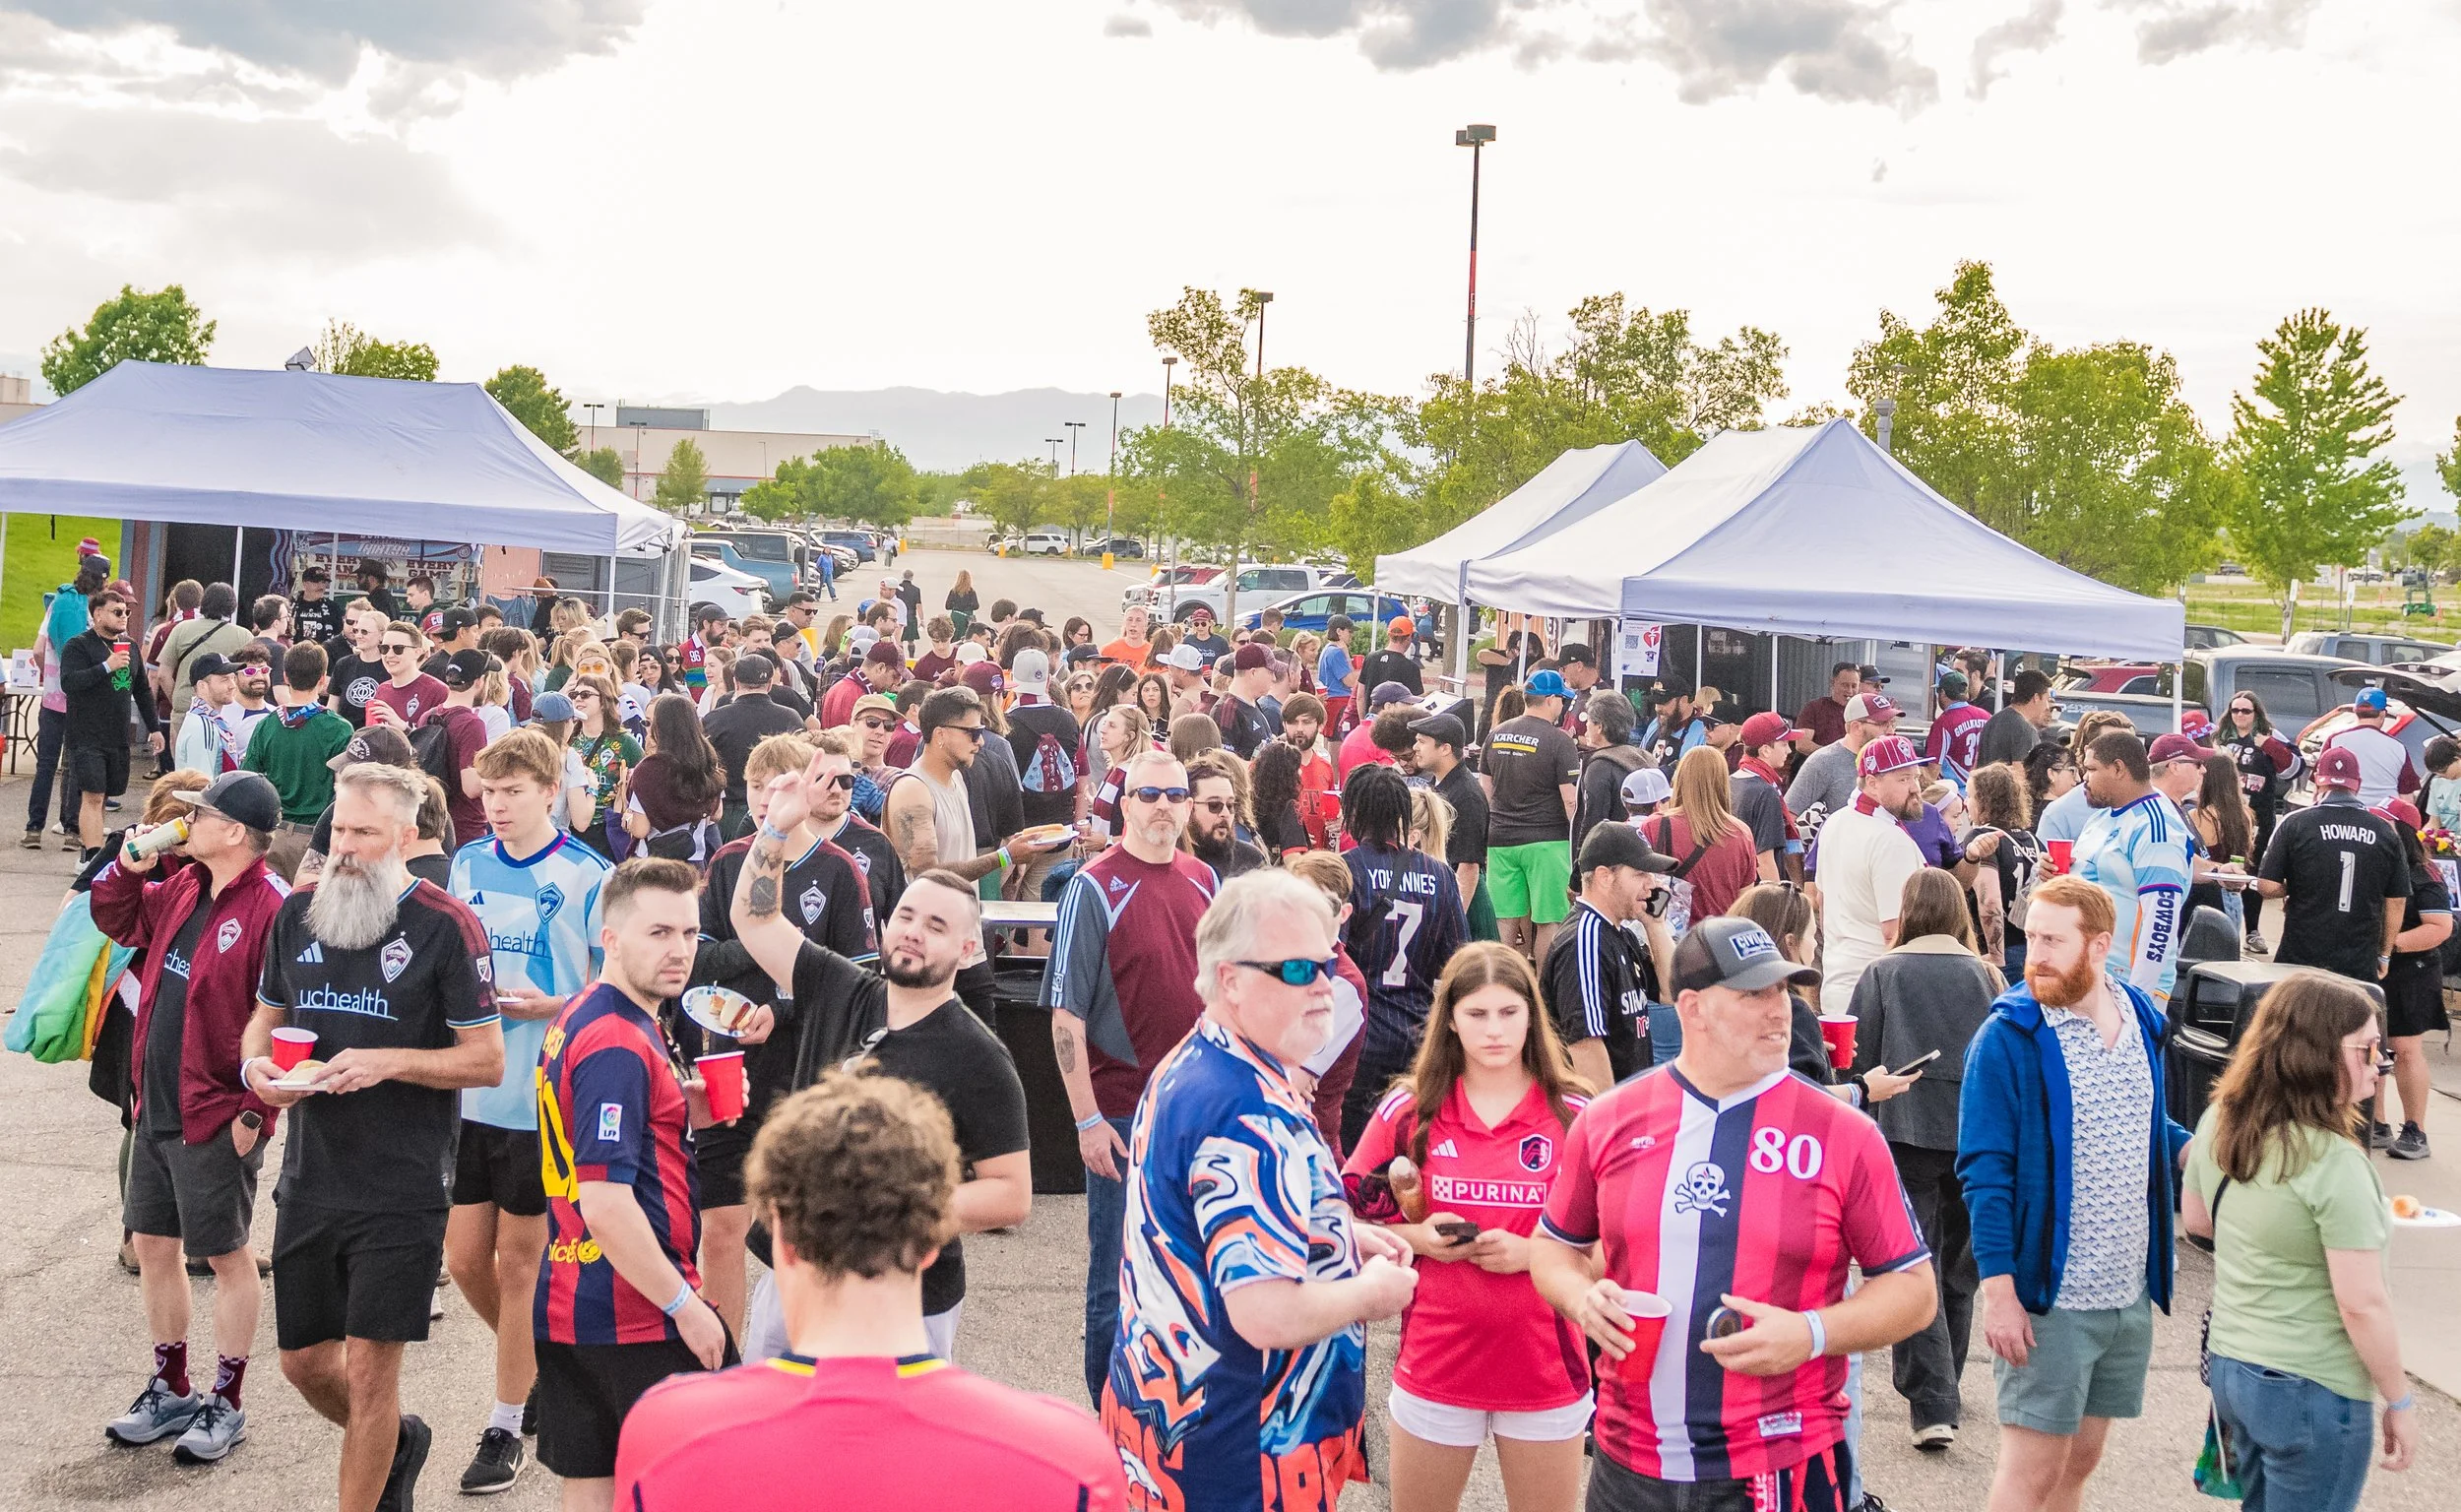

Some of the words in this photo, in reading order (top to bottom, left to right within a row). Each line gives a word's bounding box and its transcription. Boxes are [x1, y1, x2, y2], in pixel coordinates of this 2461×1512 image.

[689, 650, 702, 662] 96
[2319, 824, 2376, 845] HOWARD
[1367, 868, 1436, 896] YOHNNES
[2338, 850, 2355, 913] 1
[489, 926, 546, 957] health
[2146, 890, 2176, 964] COWBOYS
[1382, 899, 1423, 987] 7
[163, 948, 191, 978] chea
[299, 982, 389, 1017] uchealth
[1749, 1126, 1823, 1180] 80
[1456, 1182, 1541, 1203] PURINA
